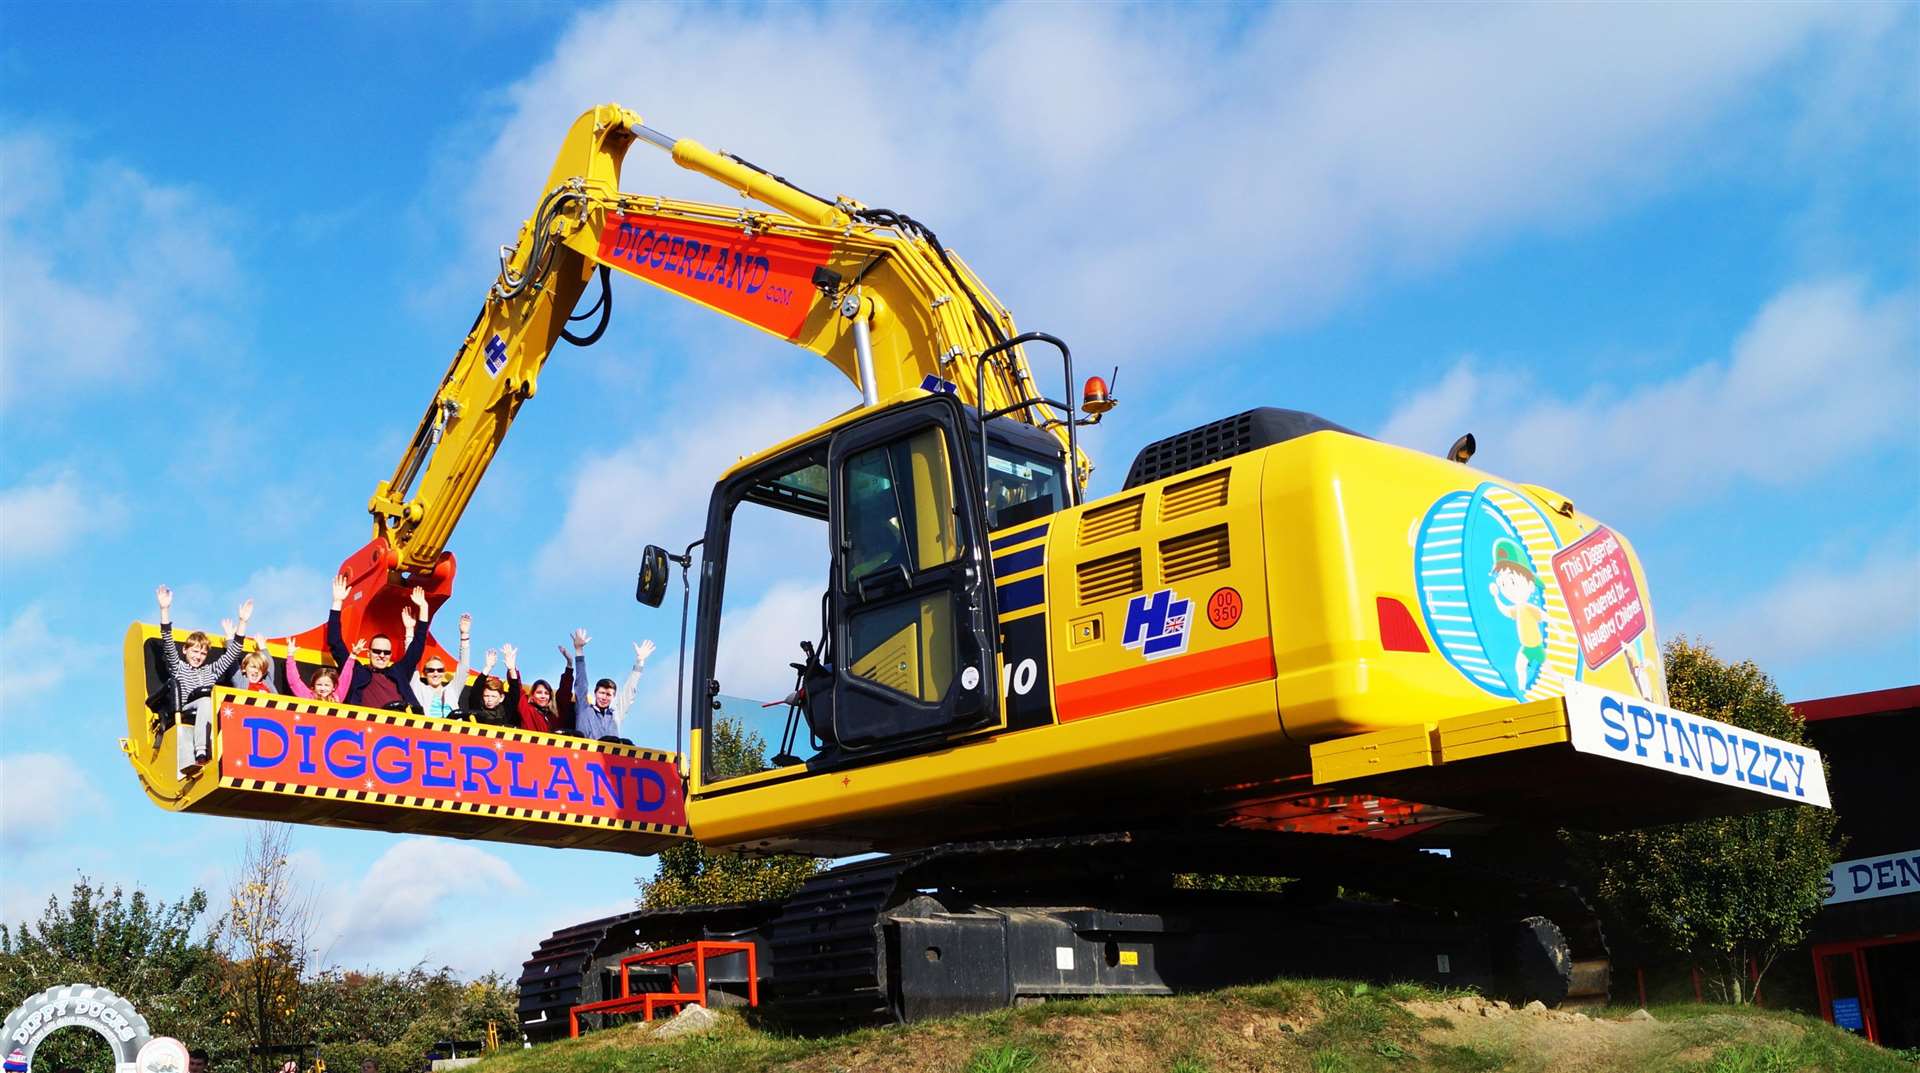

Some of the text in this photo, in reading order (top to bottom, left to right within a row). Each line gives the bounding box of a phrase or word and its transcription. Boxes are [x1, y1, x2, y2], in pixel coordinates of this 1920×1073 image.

[612, 222, 769, 294] DIGGERLAND
[1560, 556, 1583, 583] This
[1213, 605, 1238, 623] 350
[243, 717, 667, 813] DIGGERLAND
[1600, 696, 1805, 797] SPINDIZZY
[1848, 856, 1920, 894] DEN
[12, 999, 69, 1045] DIPPY
[74, 999, 137, 1042] DUCKS
